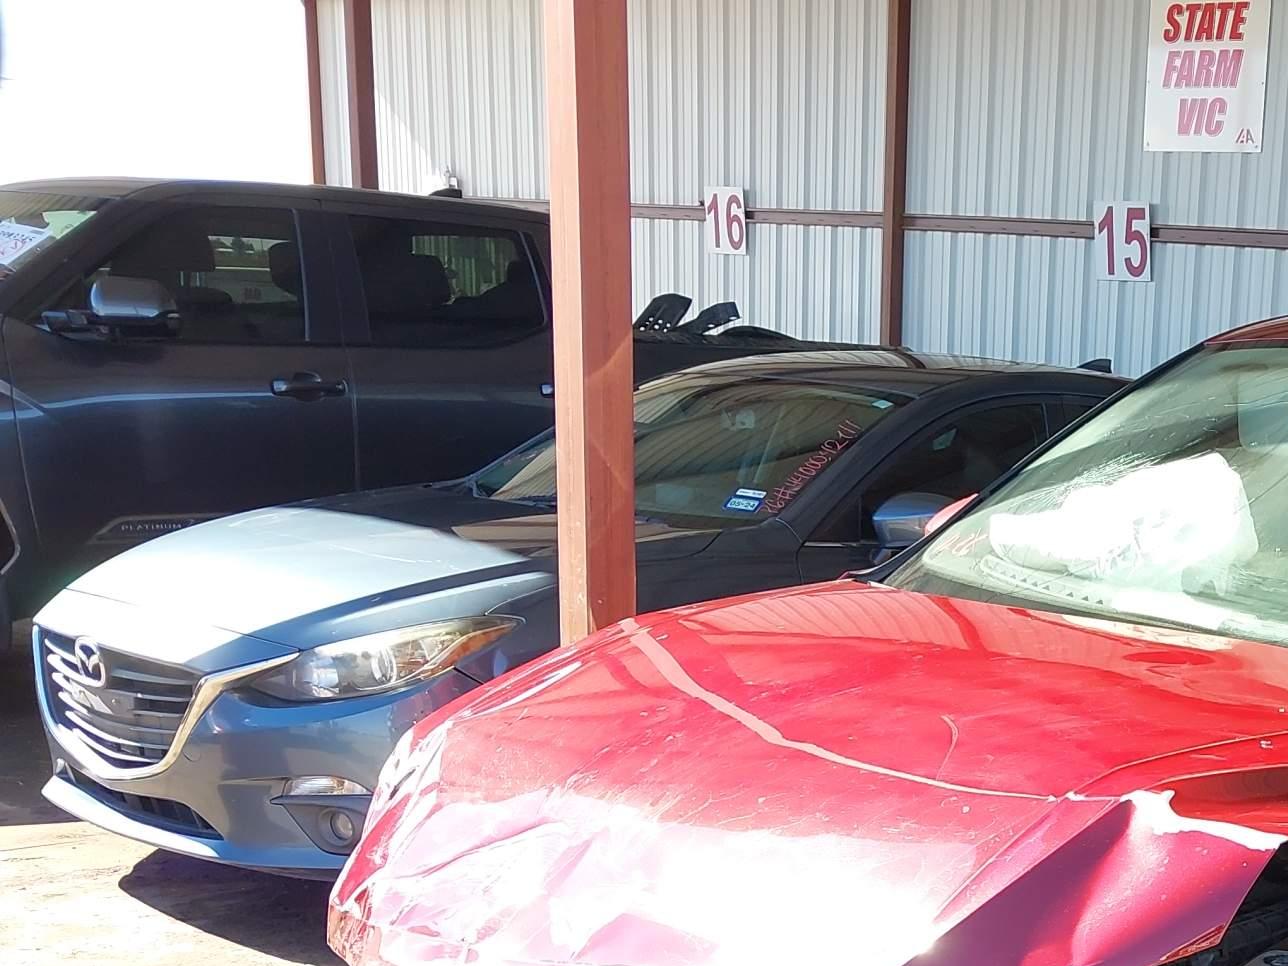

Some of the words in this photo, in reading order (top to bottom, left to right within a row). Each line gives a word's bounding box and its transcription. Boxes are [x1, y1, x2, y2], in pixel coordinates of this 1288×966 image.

[1163, 2, 1249, 42] STATE
[1162, 49, 1244, 89] FARM
[1178, 97, 1228, 137] VIC
[707, 193, 744, 251] 16
[1098, 206, 1148, 277] 15
